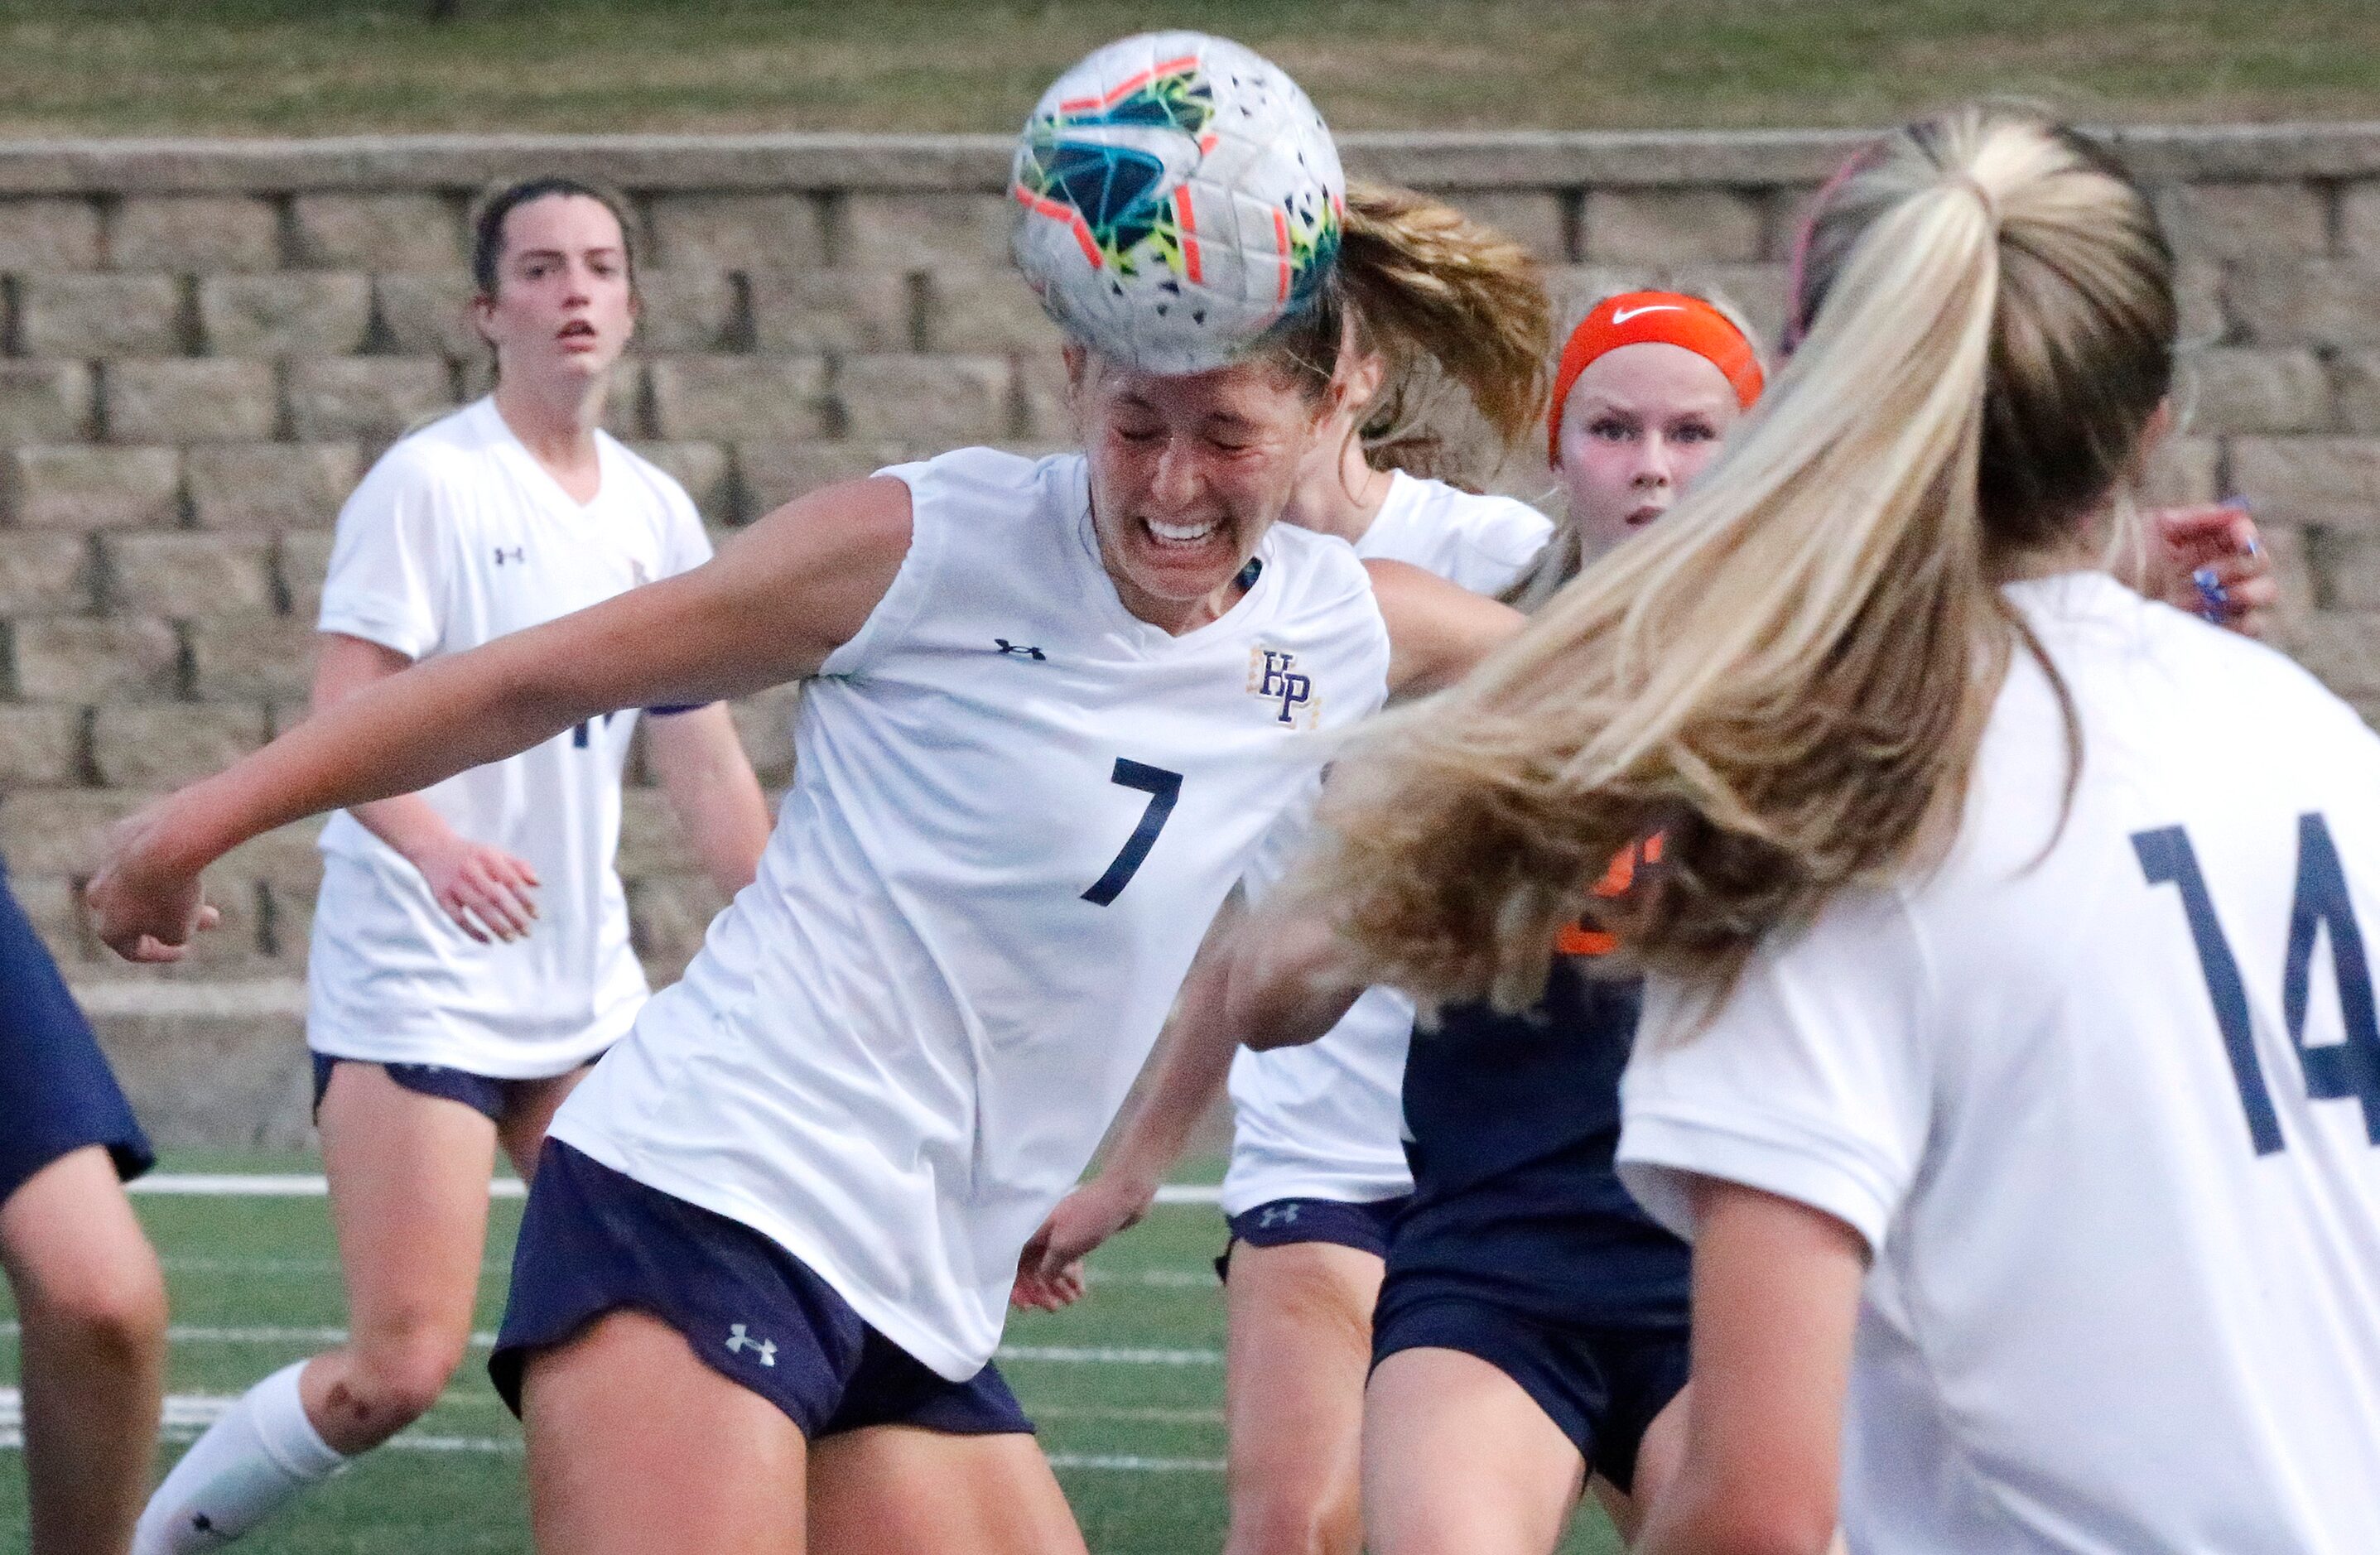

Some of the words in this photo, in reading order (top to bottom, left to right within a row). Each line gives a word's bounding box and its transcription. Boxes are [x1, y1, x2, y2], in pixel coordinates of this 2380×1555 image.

[1259, 650, 1311, 723] HP
[1080, 756, 1184, 907] 7
[2127, 811, 2380, 1158] 14
